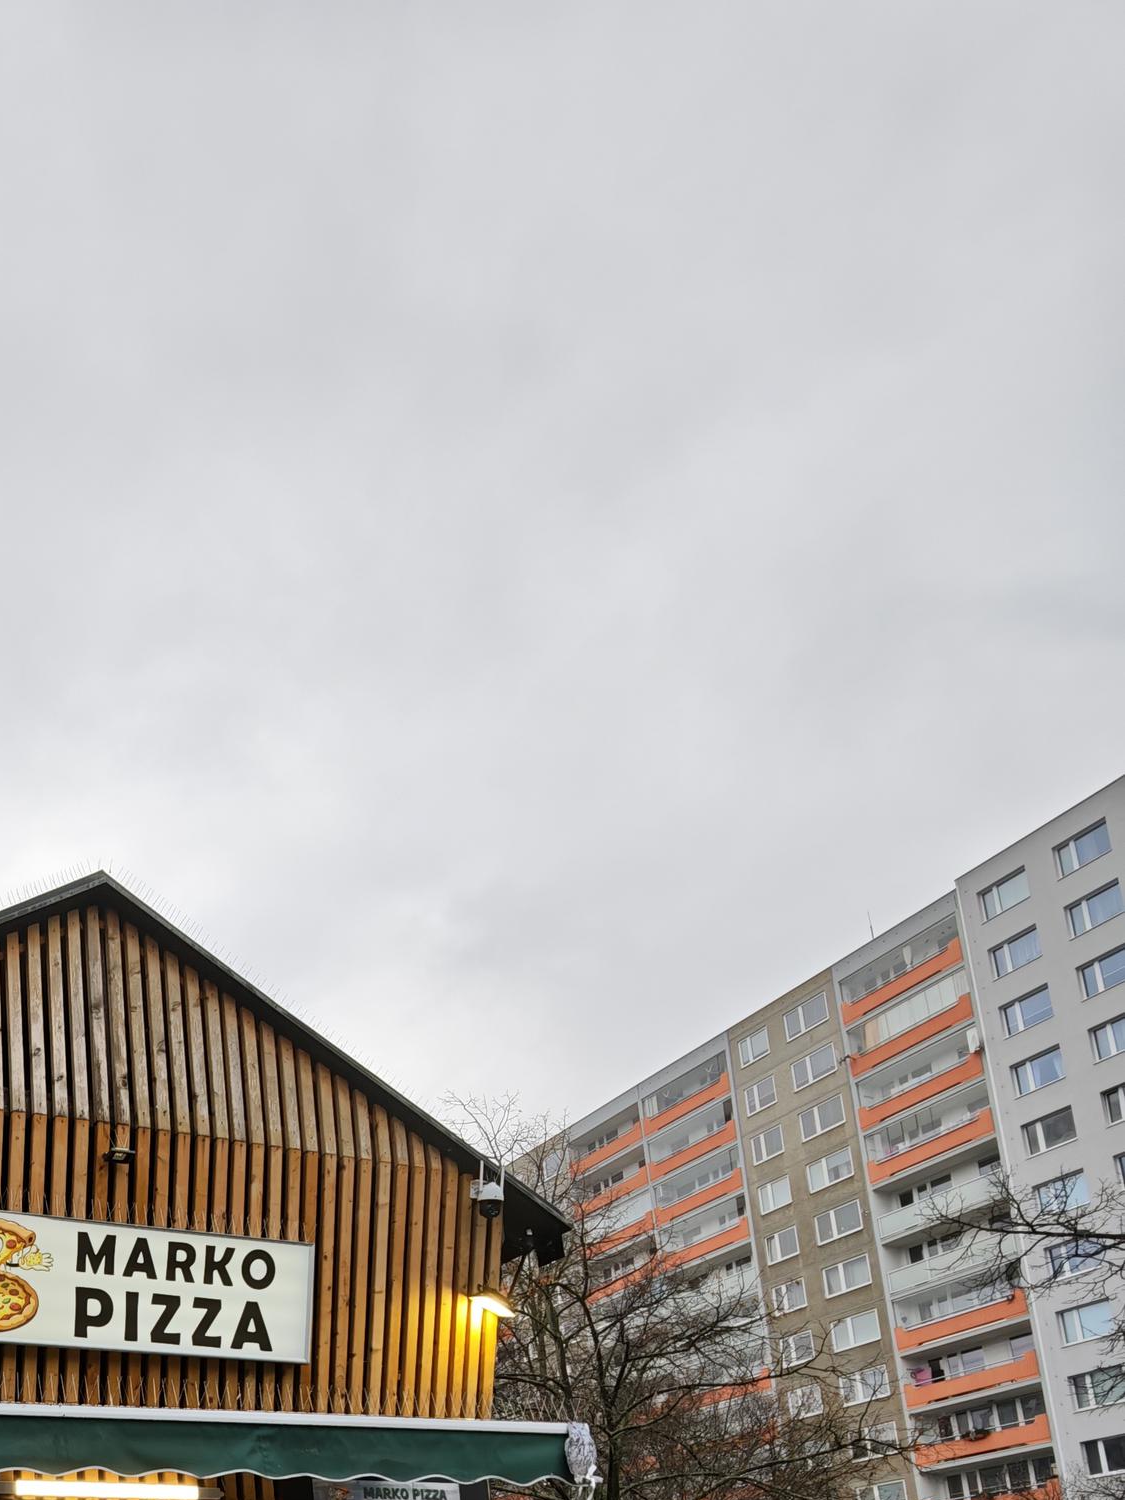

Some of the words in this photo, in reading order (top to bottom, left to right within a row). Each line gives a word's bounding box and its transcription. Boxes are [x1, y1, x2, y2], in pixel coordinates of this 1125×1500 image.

[75, 1231, 277, 1290] MARKO
[73, 1286, 273, 1352] PIZZA
[363, 1486, 409, 1500] MARKO
[412, 1488, 448, 1500] PIZZA
